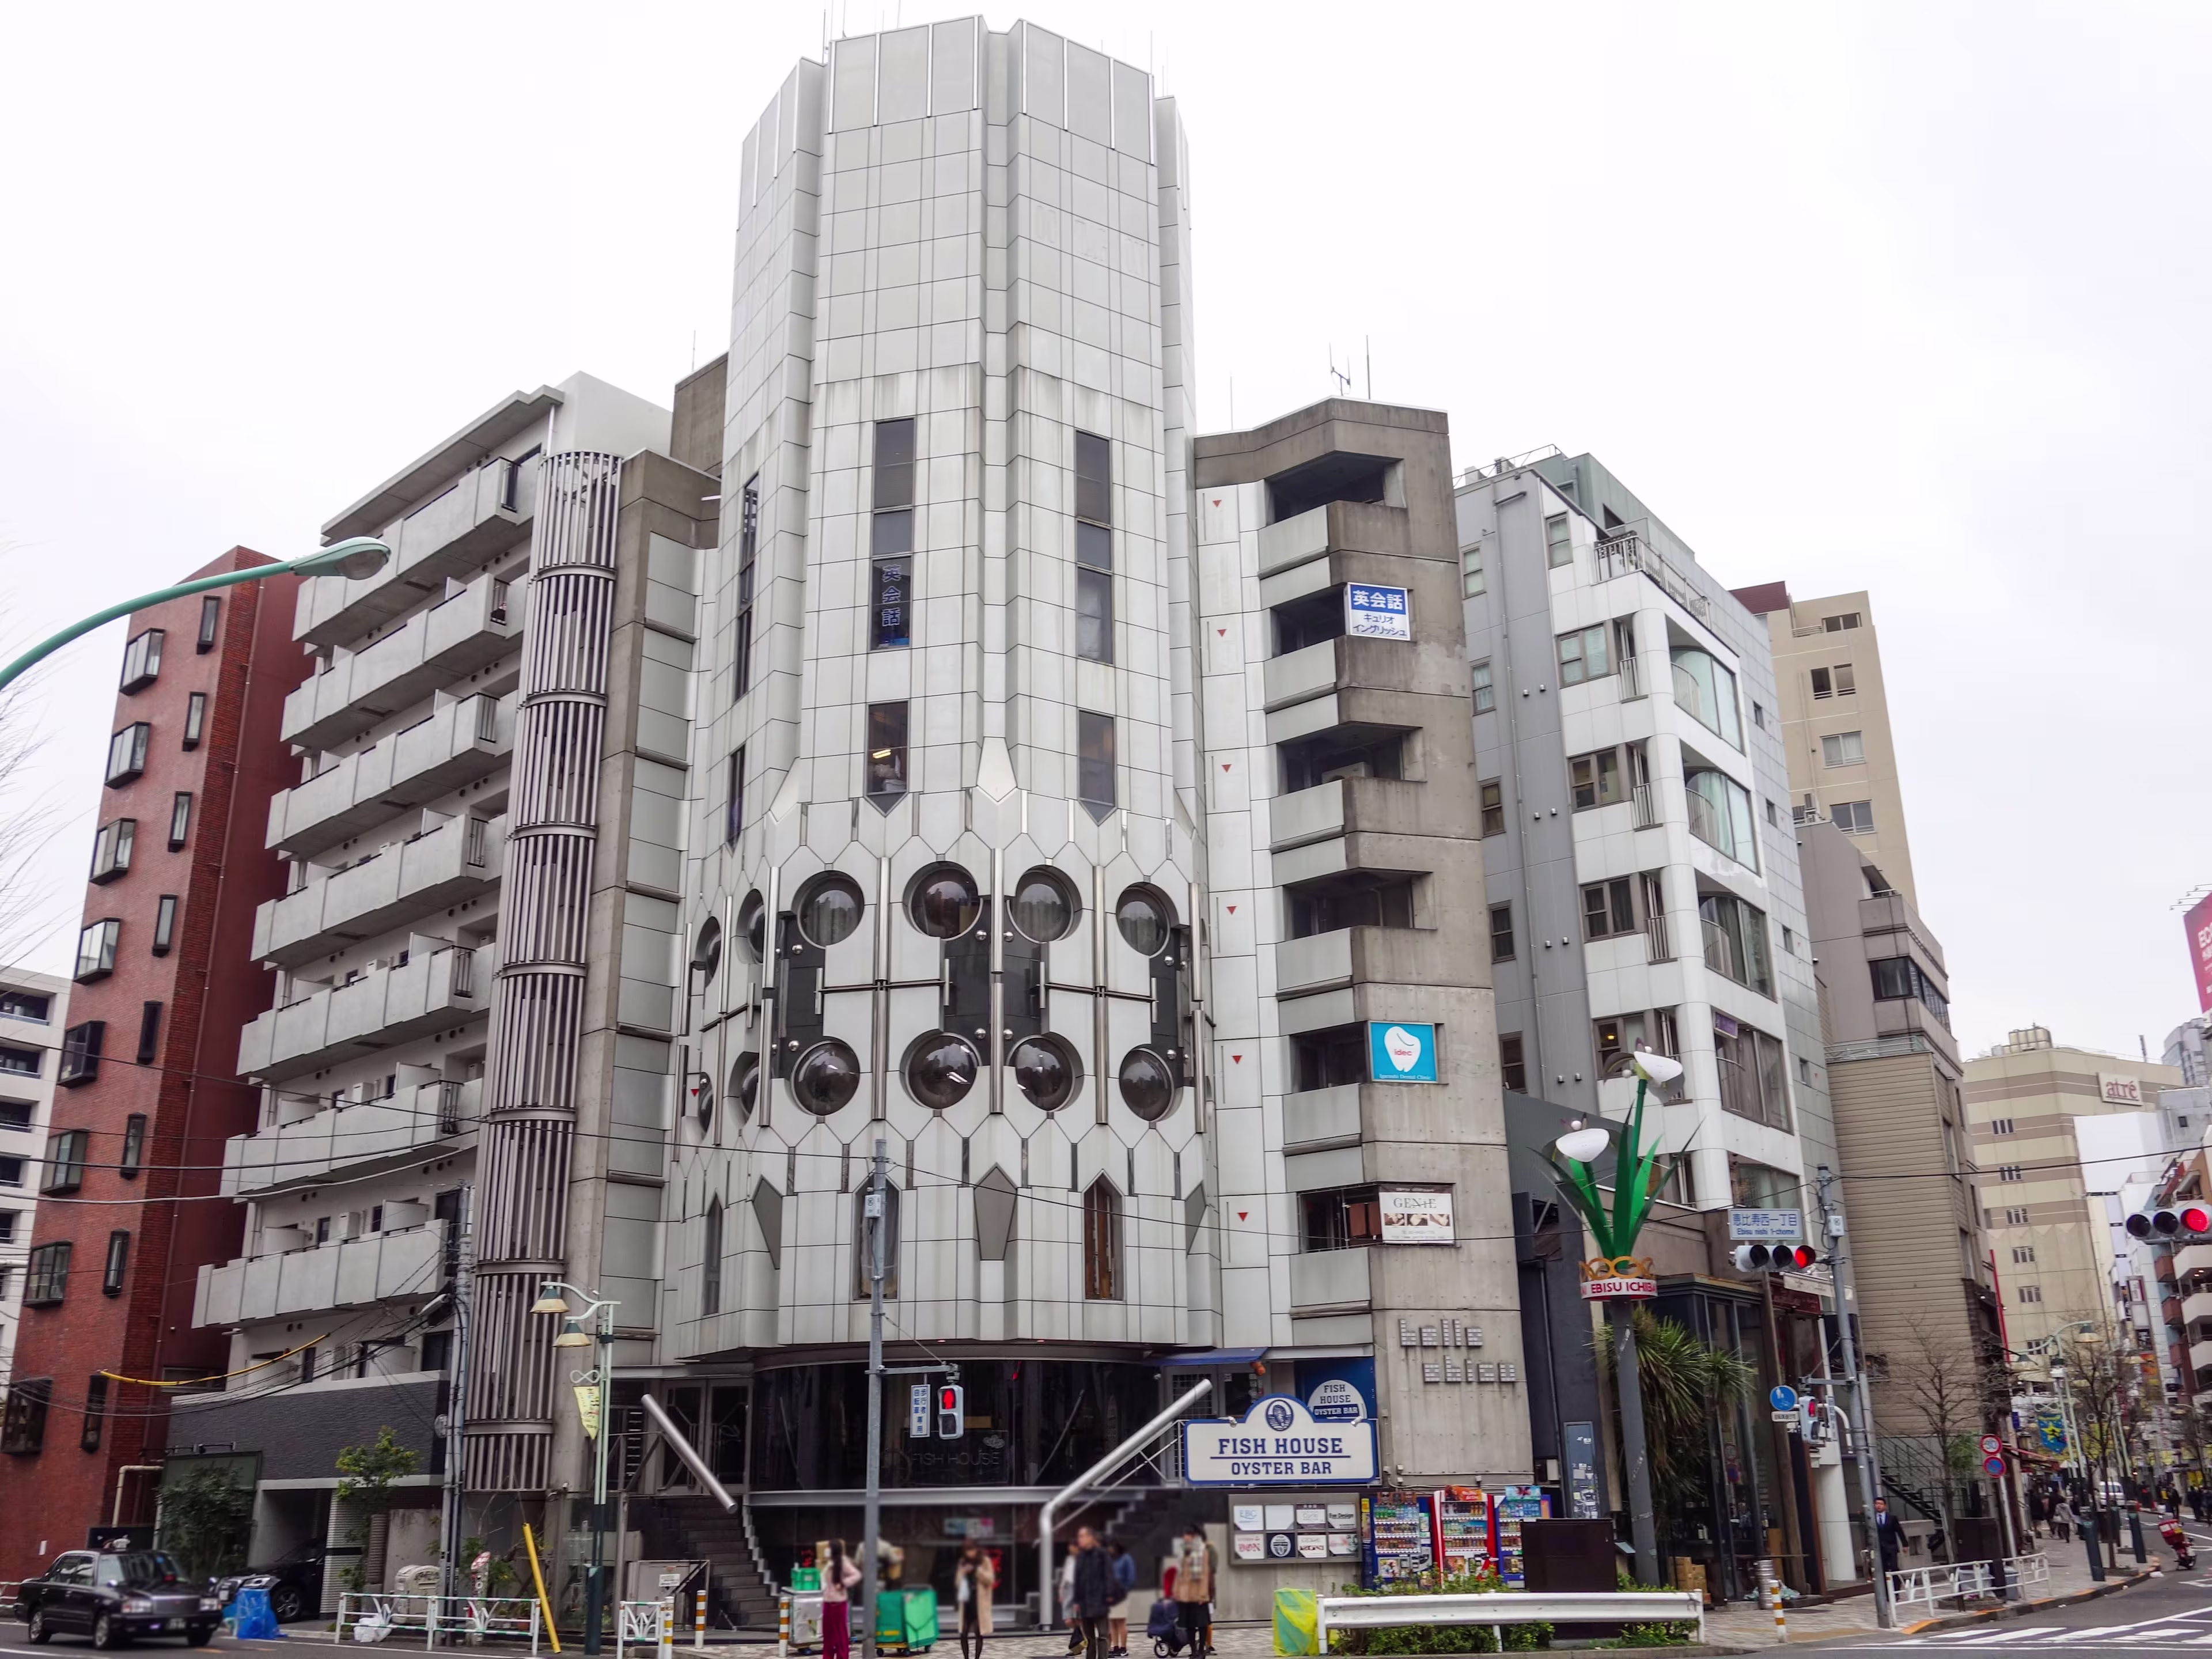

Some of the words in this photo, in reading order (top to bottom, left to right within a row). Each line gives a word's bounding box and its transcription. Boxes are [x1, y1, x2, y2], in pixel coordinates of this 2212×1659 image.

[882, 564, 902, 626] 英会話
[1353, 590, 1403, 610] 英会話
[1363, 613, 1395, 624] キュリオ
[1353, 624, 1407, 636] イングリッシュ
[2106, 1079, 2137, 1099] atré
[1733, 1214, 1797, 1226] 恵比寿西一丁目
[1591, 1282, 1622, 1293] EBISU
[1400, 1319, 1483, 1346] belle
[1324, 1384, 1346, 1393] FISH
[1320, 1395, 1351, 1404] HOUSE
[1218, 1438, 1266, 1455] FISH
[1275, 1438, 1343, 1454] HOUSE
[912, 1452, 945, 1465] FISH
[948, 1452, 1000, 1465] HOUSE
[1232, 1462, 1294, 1475] OYSTER
[1301, 1461, 1332, 1474] BAR
